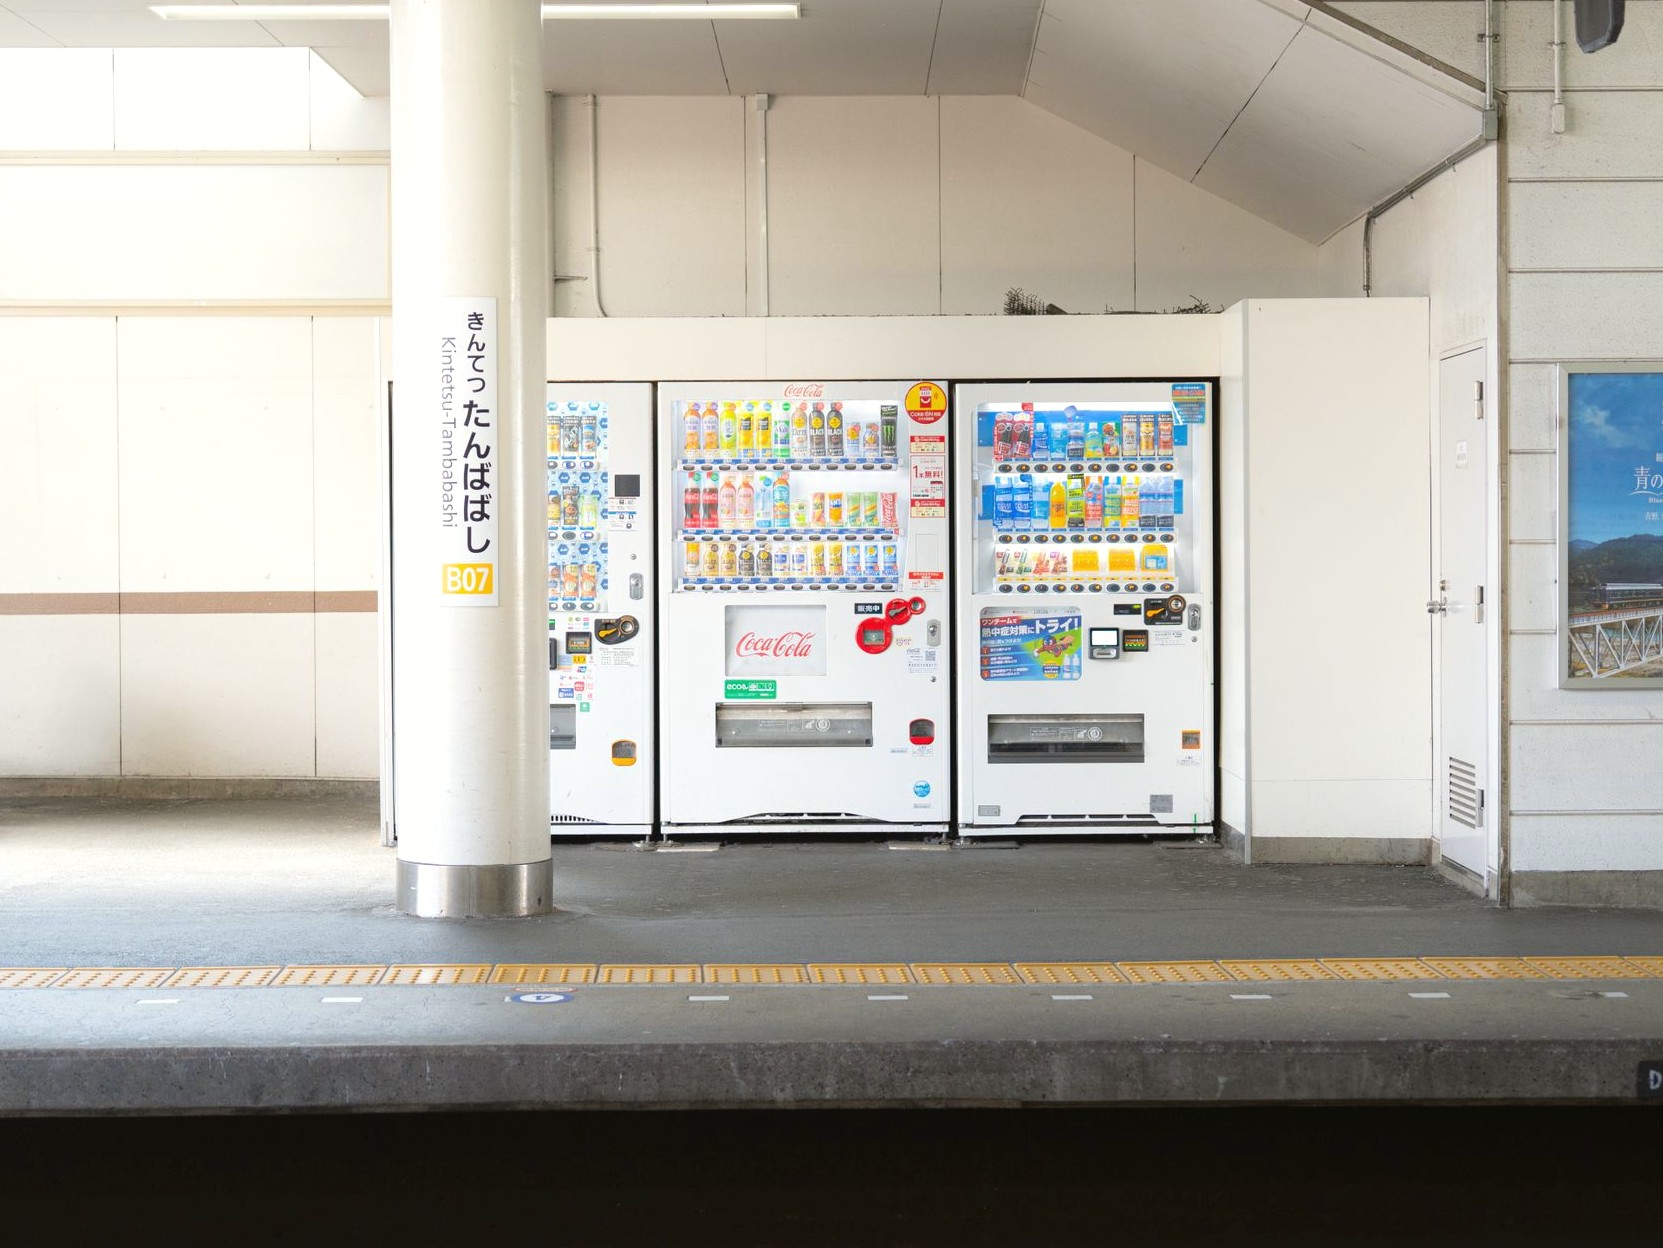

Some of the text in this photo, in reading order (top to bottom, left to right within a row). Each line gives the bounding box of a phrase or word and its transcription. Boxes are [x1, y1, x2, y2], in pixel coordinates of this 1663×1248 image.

[784, 384, 824, 397] Coca-Cola
[441, 337, 458, 527] Kintetsu-Tambabashi
[446, 568, 489, 592] B07
[736, 632, 815, 657] Coca-Cola
[1649, 1069, 1662, 1090] D
